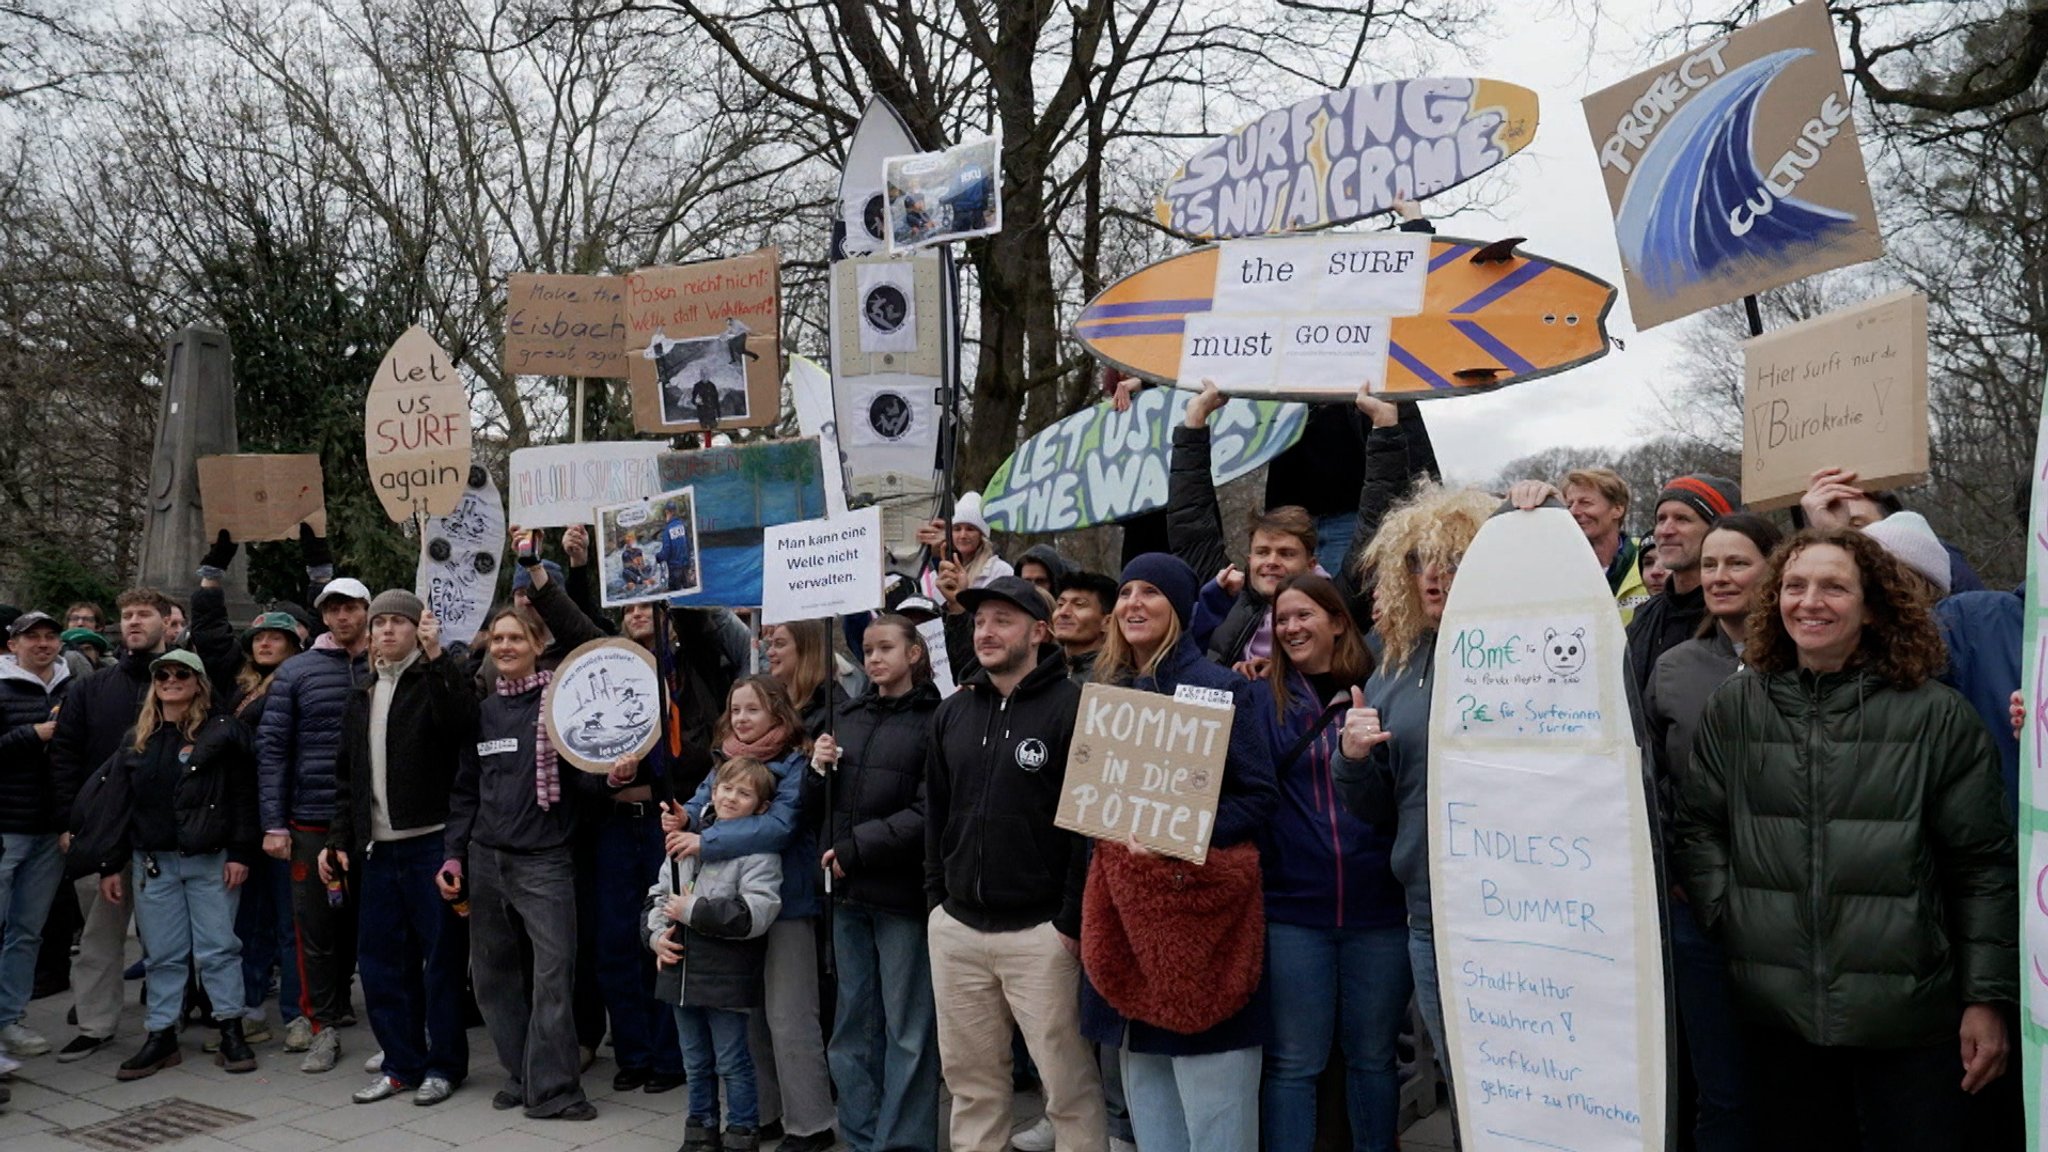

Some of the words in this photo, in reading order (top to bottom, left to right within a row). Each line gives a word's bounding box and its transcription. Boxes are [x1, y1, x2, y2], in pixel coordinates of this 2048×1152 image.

[1601, 38, 1730, 175] PROTECT
[1730, 93, 1850, 236] CULTURE
[1219, 170, 1289, 234] NOT
[1286, 165, 1317, 228] A
[1241, 257, 1294, 284] the
[1328, 250, 1414, 275] SURF
[529, 283, 577, 302] Make
[593, 286, 621, 302] the
[510, 308, 626, 339] Eisbach
[1191, 332, 1272, 357] must
[1296, 325, 1329, 344] GO
[1336, 325, 1371, 344] ON
[393, 354, 446, 383] let
[516, 346, 576, 367] great
[1758, 363, 1798, 391] Hier
[1852, 352, 1877, 367] nur
[398, 394, 430, 415] us
[377, 413, 460, 454] SURF
[1011, 407, 1095, 490] LET
[1103, 389, 1165, 458] US
[380, 460, 459, 500] again
[983, 473, 1079, 532] THE
[778, 537, 805, 550] Man
[809, 533, 838, 546] kann
[841, 526, 866, 540] eine
[787, 554, 824, 569] Welle
[827, 548, 858, 563] nicht
[788, 572, 856, 590] verwalten.
[1085, 697, 1222, 757] KOMMT
[1448, 802, 1591, 871] ENDLESS
[1482, 879, 1605, 934] BUMMER
[1463, 960, 1575, 1000] Stadtkultur
[1479, 1041, 1582, 1083] Surfkultur
[1481, 1080, 1532, 1104] gehört
[1543, 1094, 1563, 1109] zu
[1568, 1094, 1641, 1125] München
